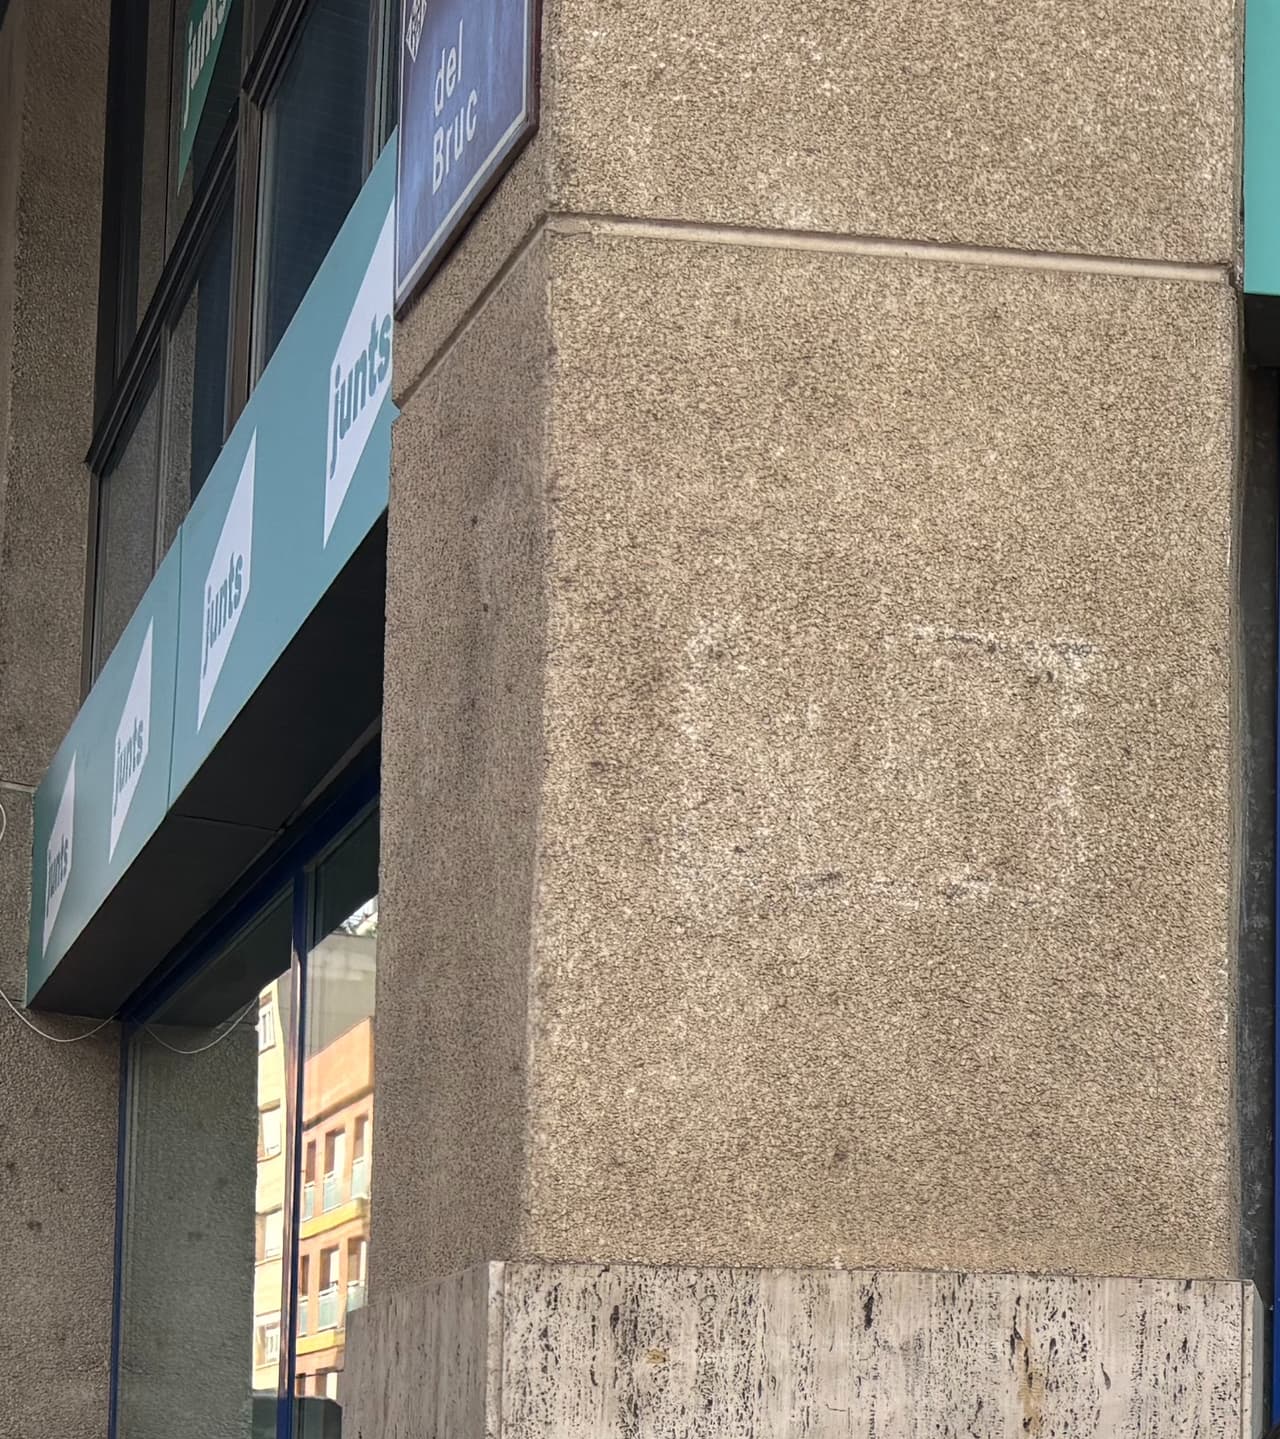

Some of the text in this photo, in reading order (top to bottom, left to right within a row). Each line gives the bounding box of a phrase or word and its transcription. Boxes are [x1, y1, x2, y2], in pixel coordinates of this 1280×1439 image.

[434, 17, 463, 118] del
[432, 88, 477, 195] Bruc
[330, 312, 391, 480] junts
[203, 551, 243, 679] junts
[114, 716, 143, 817] junts
[46, 834, 68, 918] junts
